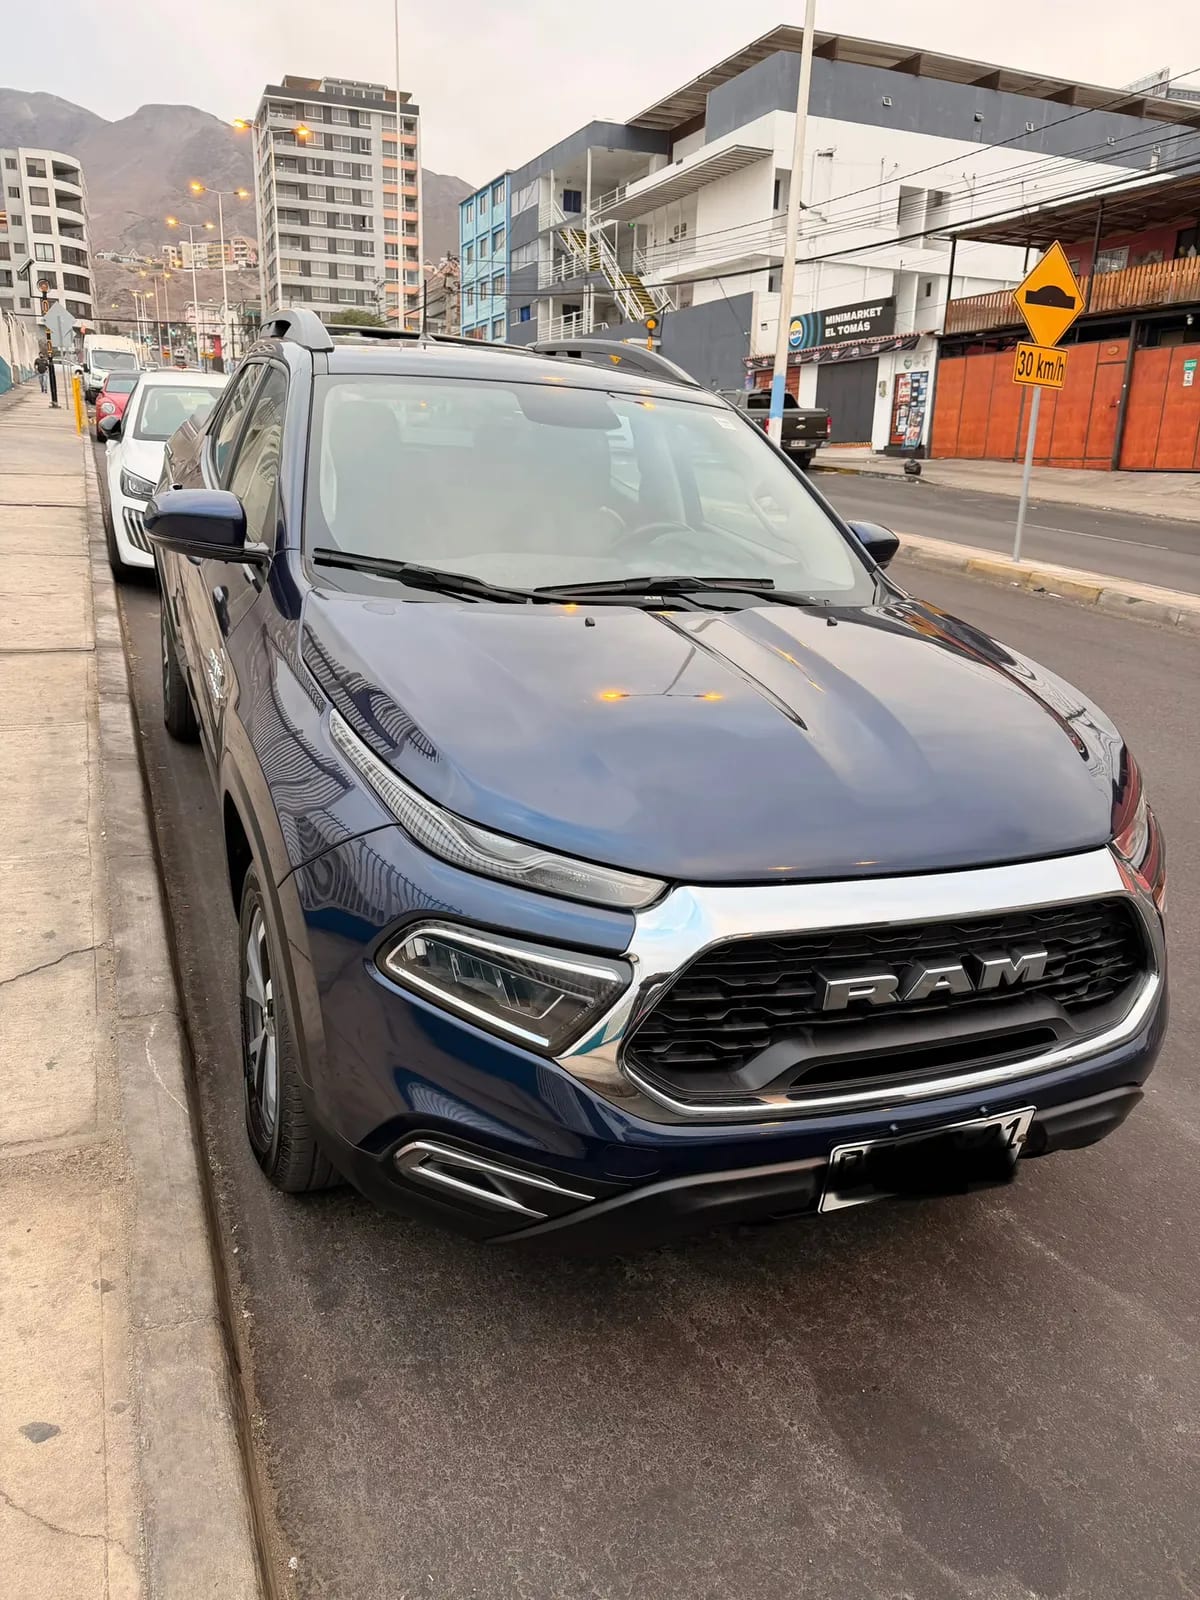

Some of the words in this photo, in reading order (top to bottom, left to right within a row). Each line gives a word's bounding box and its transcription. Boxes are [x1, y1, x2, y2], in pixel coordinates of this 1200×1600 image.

[825, 307, 882, 325] MINIMARKET
[825, 327, 836, 337] EL
[837, 321, 870, 335] TOMÁS
[1018, 351, 1033, 376] 30
[1036, 353, 1063, 381] km/h
[823, 952, 1048, 1011] RAM
